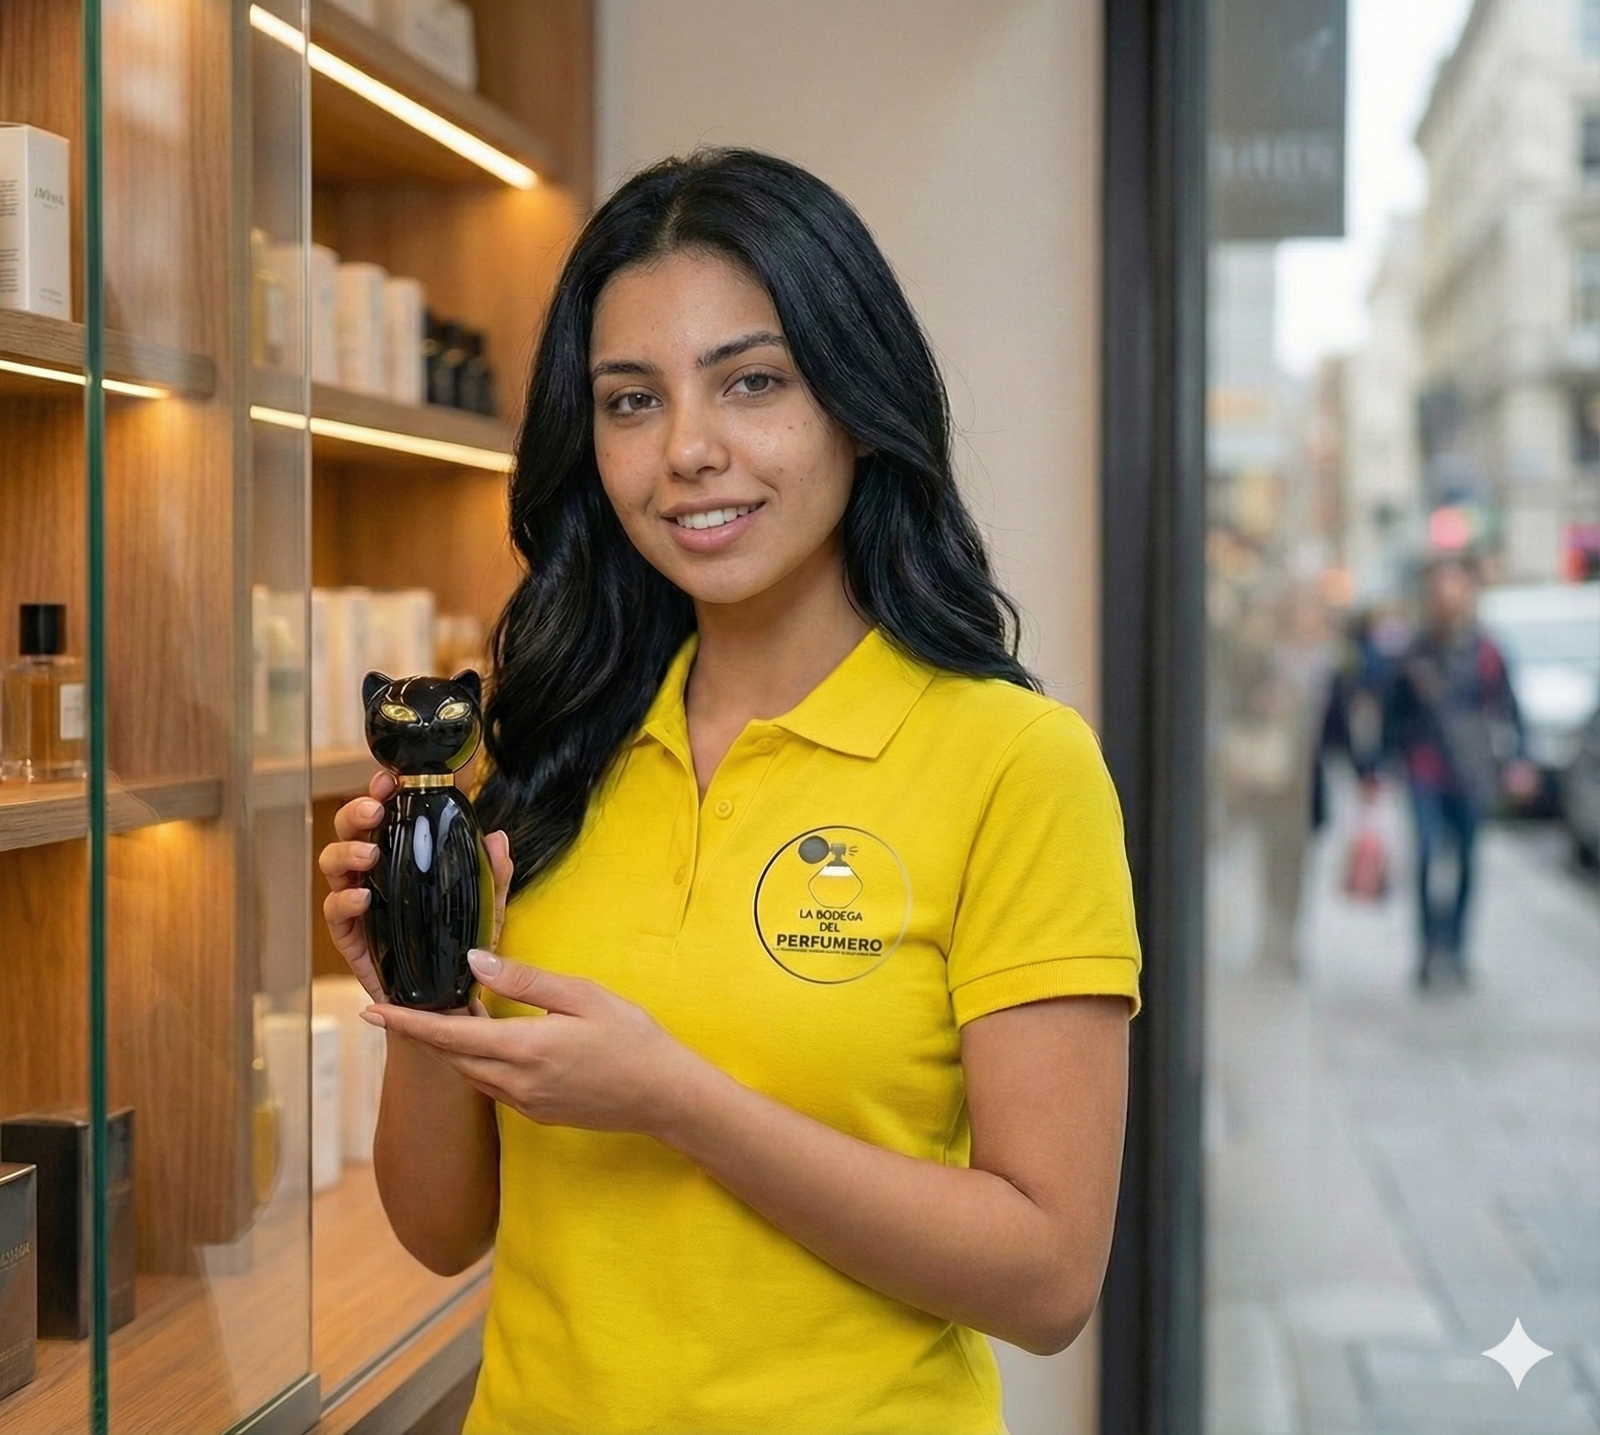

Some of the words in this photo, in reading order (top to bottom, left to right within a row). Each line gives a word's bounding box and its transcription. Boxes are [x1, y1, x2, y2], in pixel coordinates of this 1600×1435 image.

[799, 909, 814, 919] LA
[816, 910, 863, 921] BODEGA
[819, 922, 840, 932] DEL
[776, 934, 883, 952] PERFUMERO
